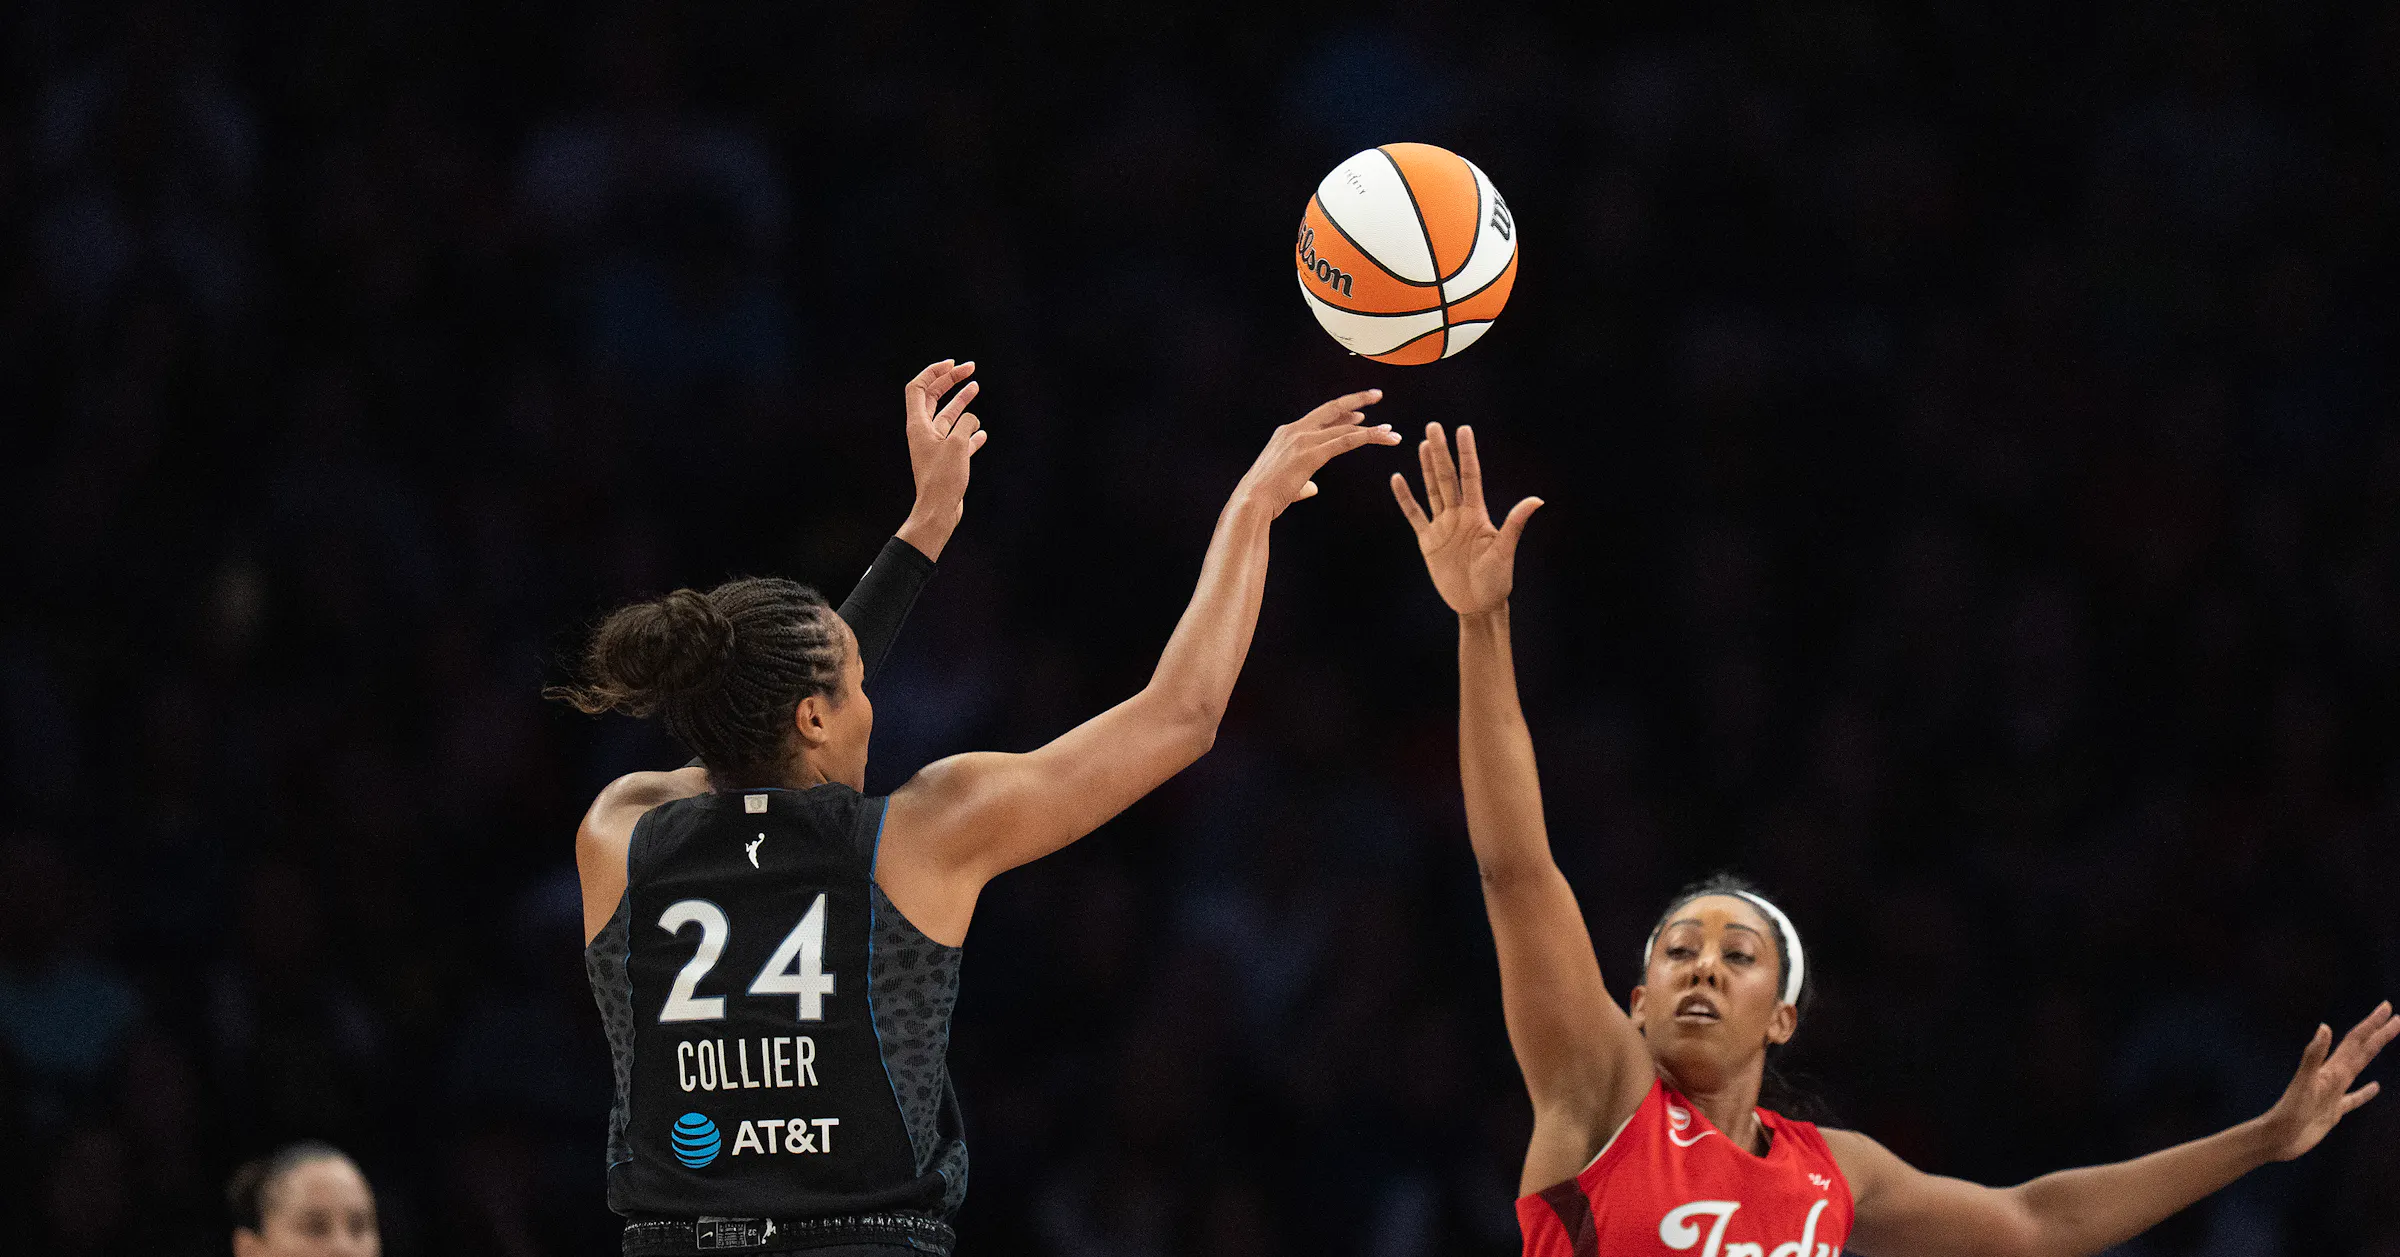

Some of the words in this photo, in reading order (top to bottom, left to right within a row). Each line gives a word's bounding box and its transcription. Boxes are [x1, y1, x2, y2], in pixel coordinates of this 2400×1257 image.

[1298, 217, 1353, 299] ilson
[656, 892, 836, 1023] 24
[677, 1035, 819, 1092] COLLIER
[731, 1117, 840, 1157] AT&T
[1659, 1199, 1841, 1257] Id
